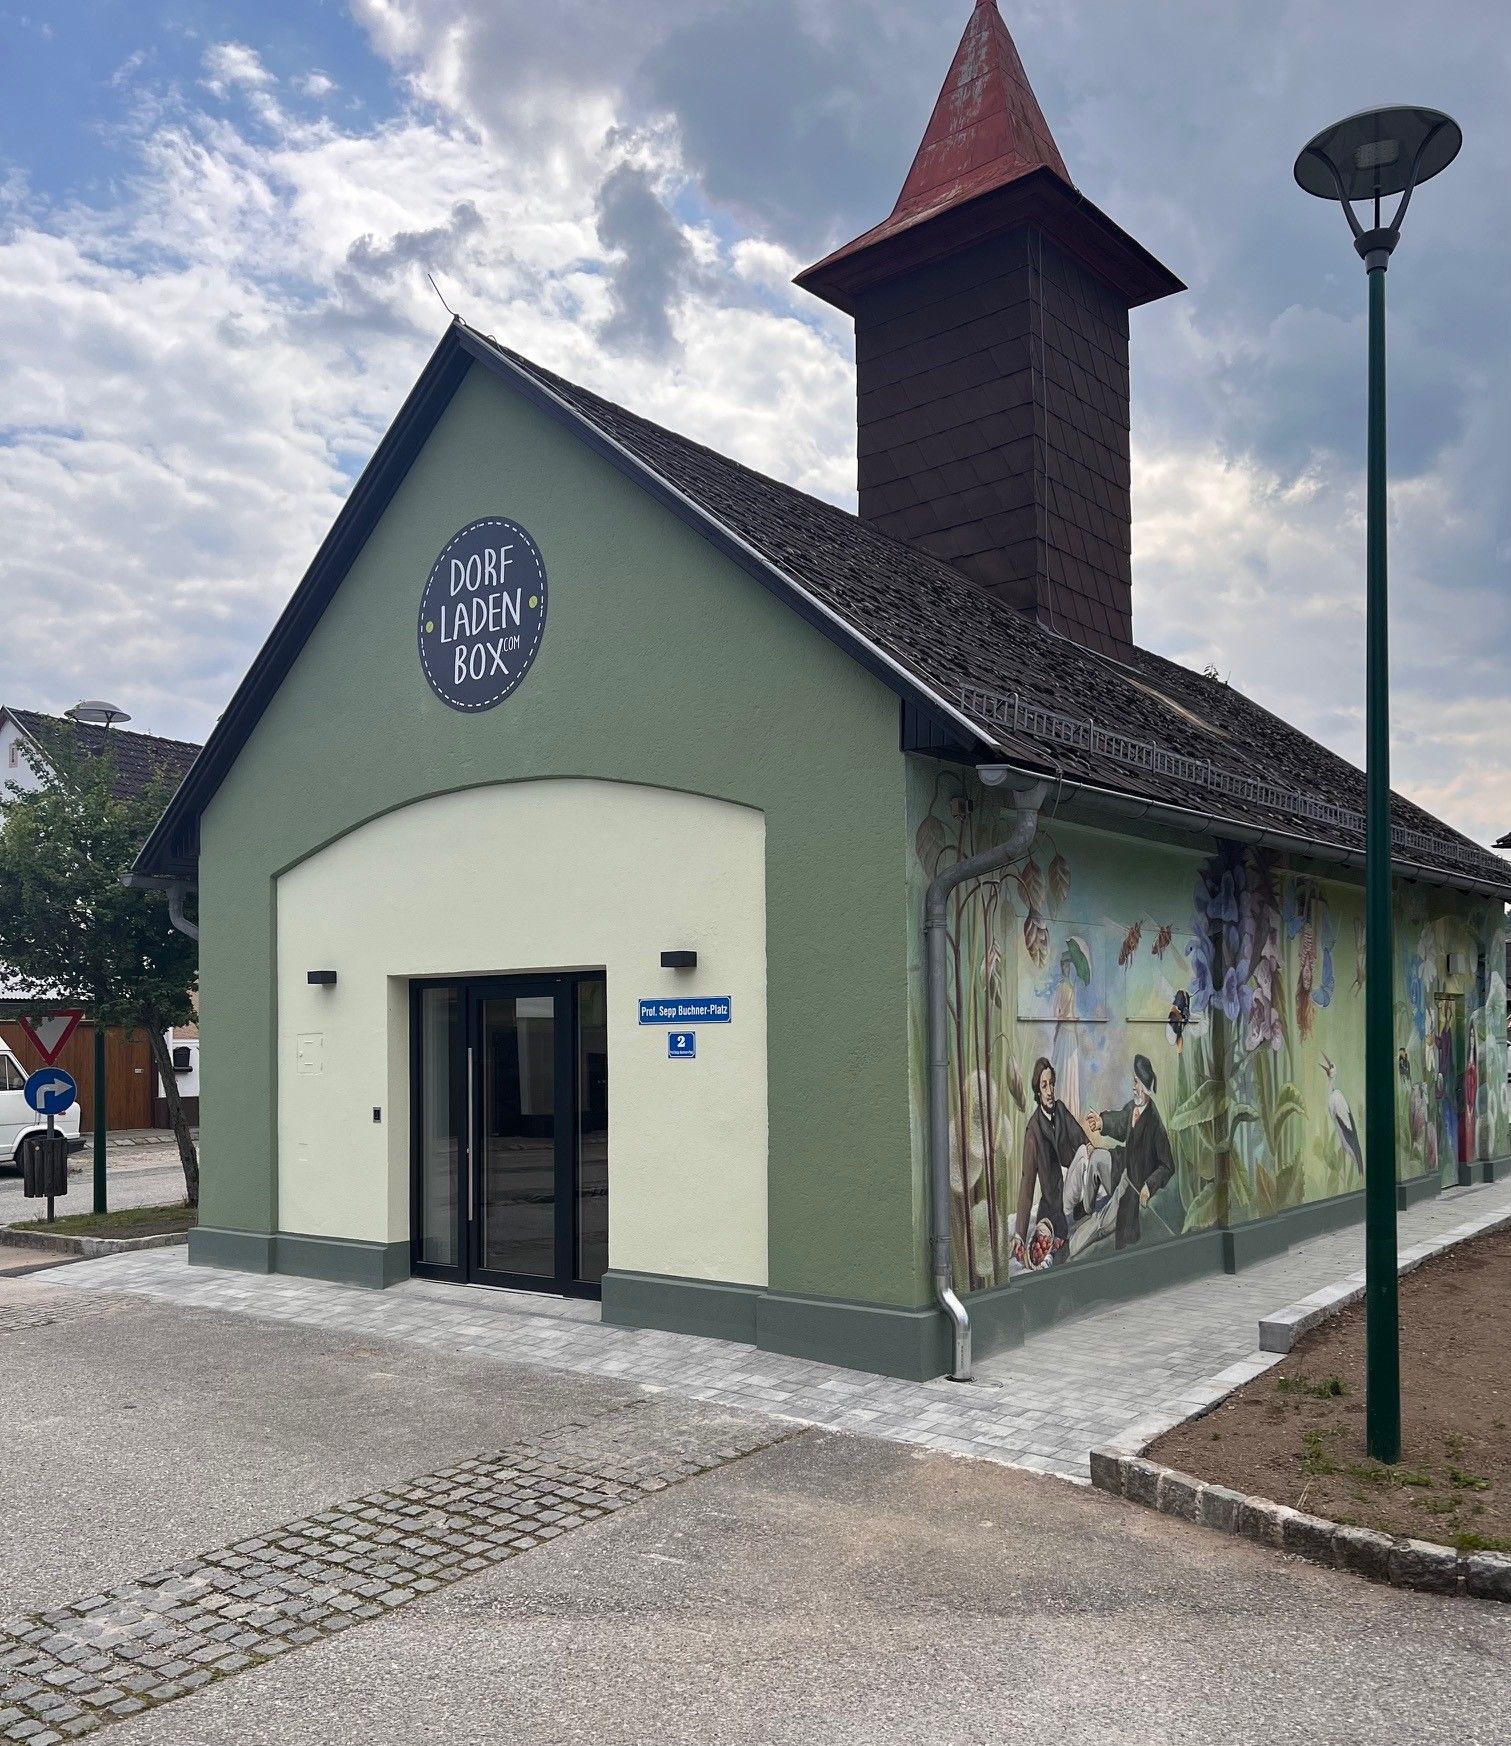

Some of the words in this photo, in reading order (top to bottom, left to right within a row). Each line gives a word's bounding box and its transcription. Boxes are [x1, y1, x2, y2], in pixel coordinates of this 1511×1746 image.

[450, 545, 514, 597] DORF
[441, 587, 522, 643] LADEN
[641, 1006, 657, 1017] Prof.
[659, 1005, 676, 1018] Sepp
[678, 1004, 728, 1016] Buchner-Platz
[677, 1035, 686, 1048] 2
